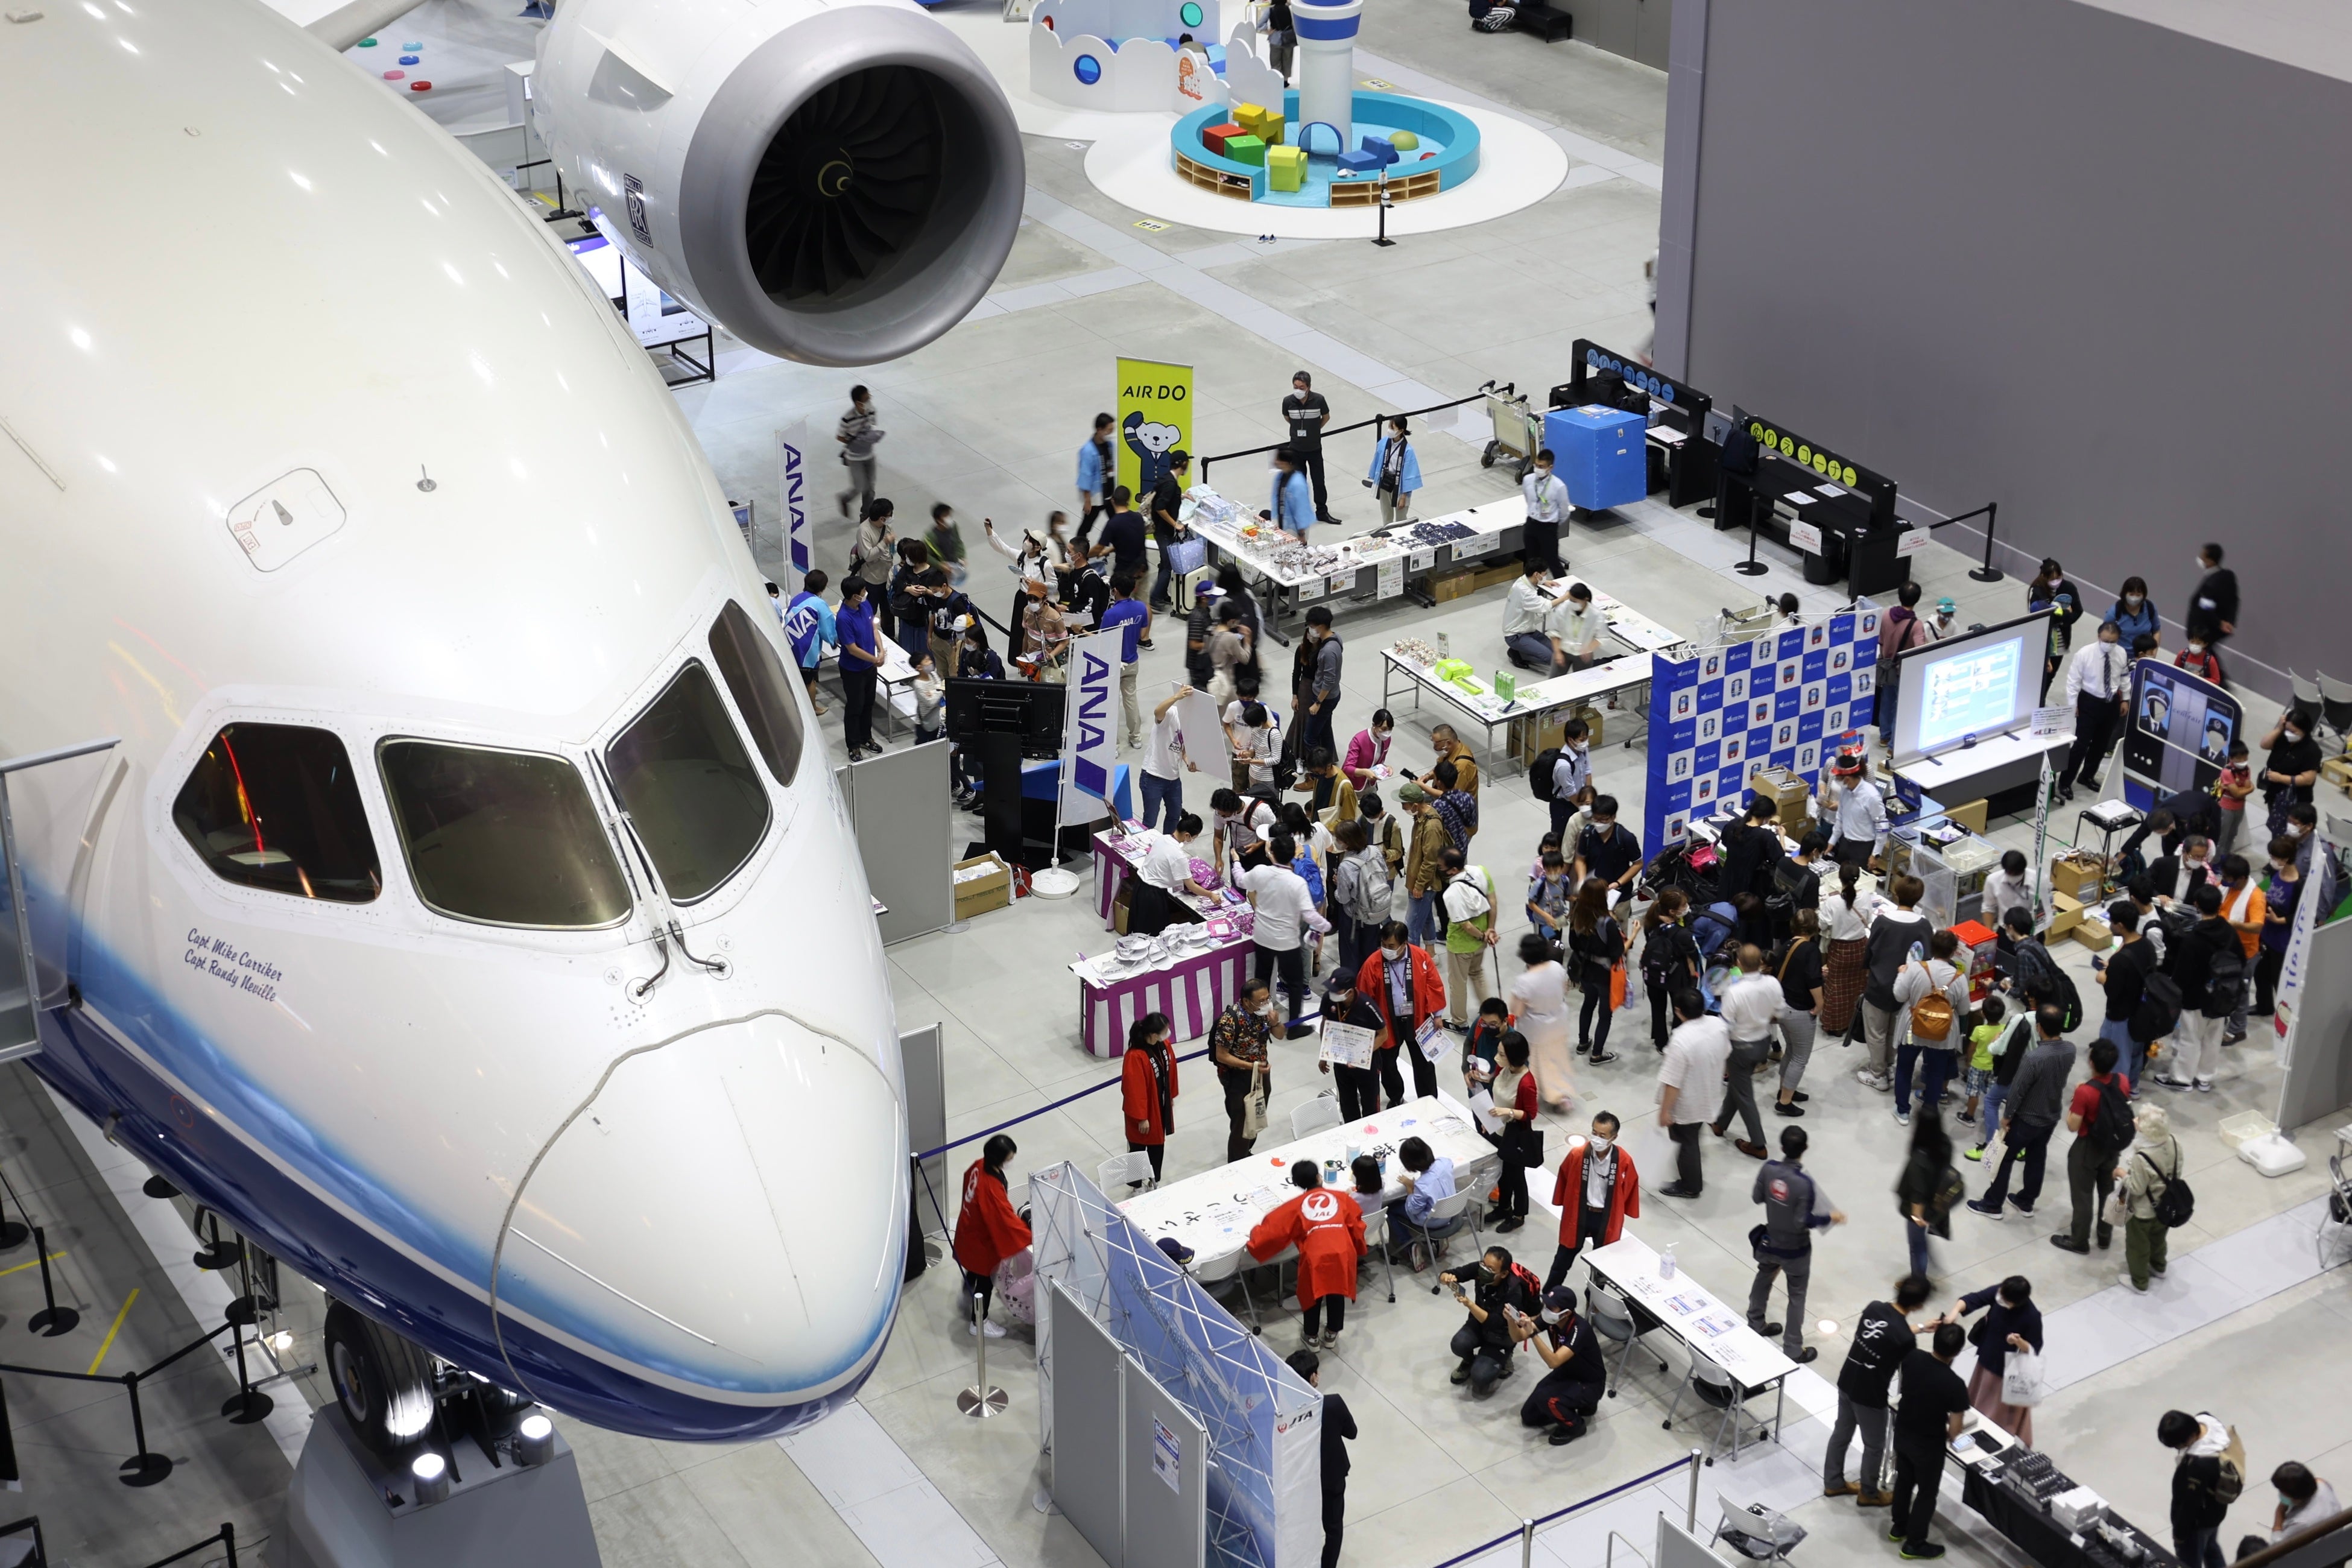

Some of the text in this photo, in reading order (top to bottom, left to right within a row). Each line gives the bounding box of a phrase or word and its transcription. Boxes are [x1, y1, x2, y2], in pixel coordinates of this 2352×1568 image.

[625, 178, 642, 192] ROLLS
[1122, 385, 1186, 401] AIR DO
[1751, 424, 1856, 484] ぬりえコーナー
[783, 442, 805, 535] ANA
[242, 536, 257, 550] EXIT
[784, 609, 818, 646] NA
[1118, 617, 1134, 627] ANA
[1076, 650, 1109, 753] ANA
[2172, 708, 2202, 724] centrair
[188, 928, 282, 981] Capt. Mike Carriker
[185, 949, 276, 1002] Capt. Randy Neville
[1608, 1163, 1617, 1186] 日本航空
[1289, 1410, 1313, 1427] JTA
